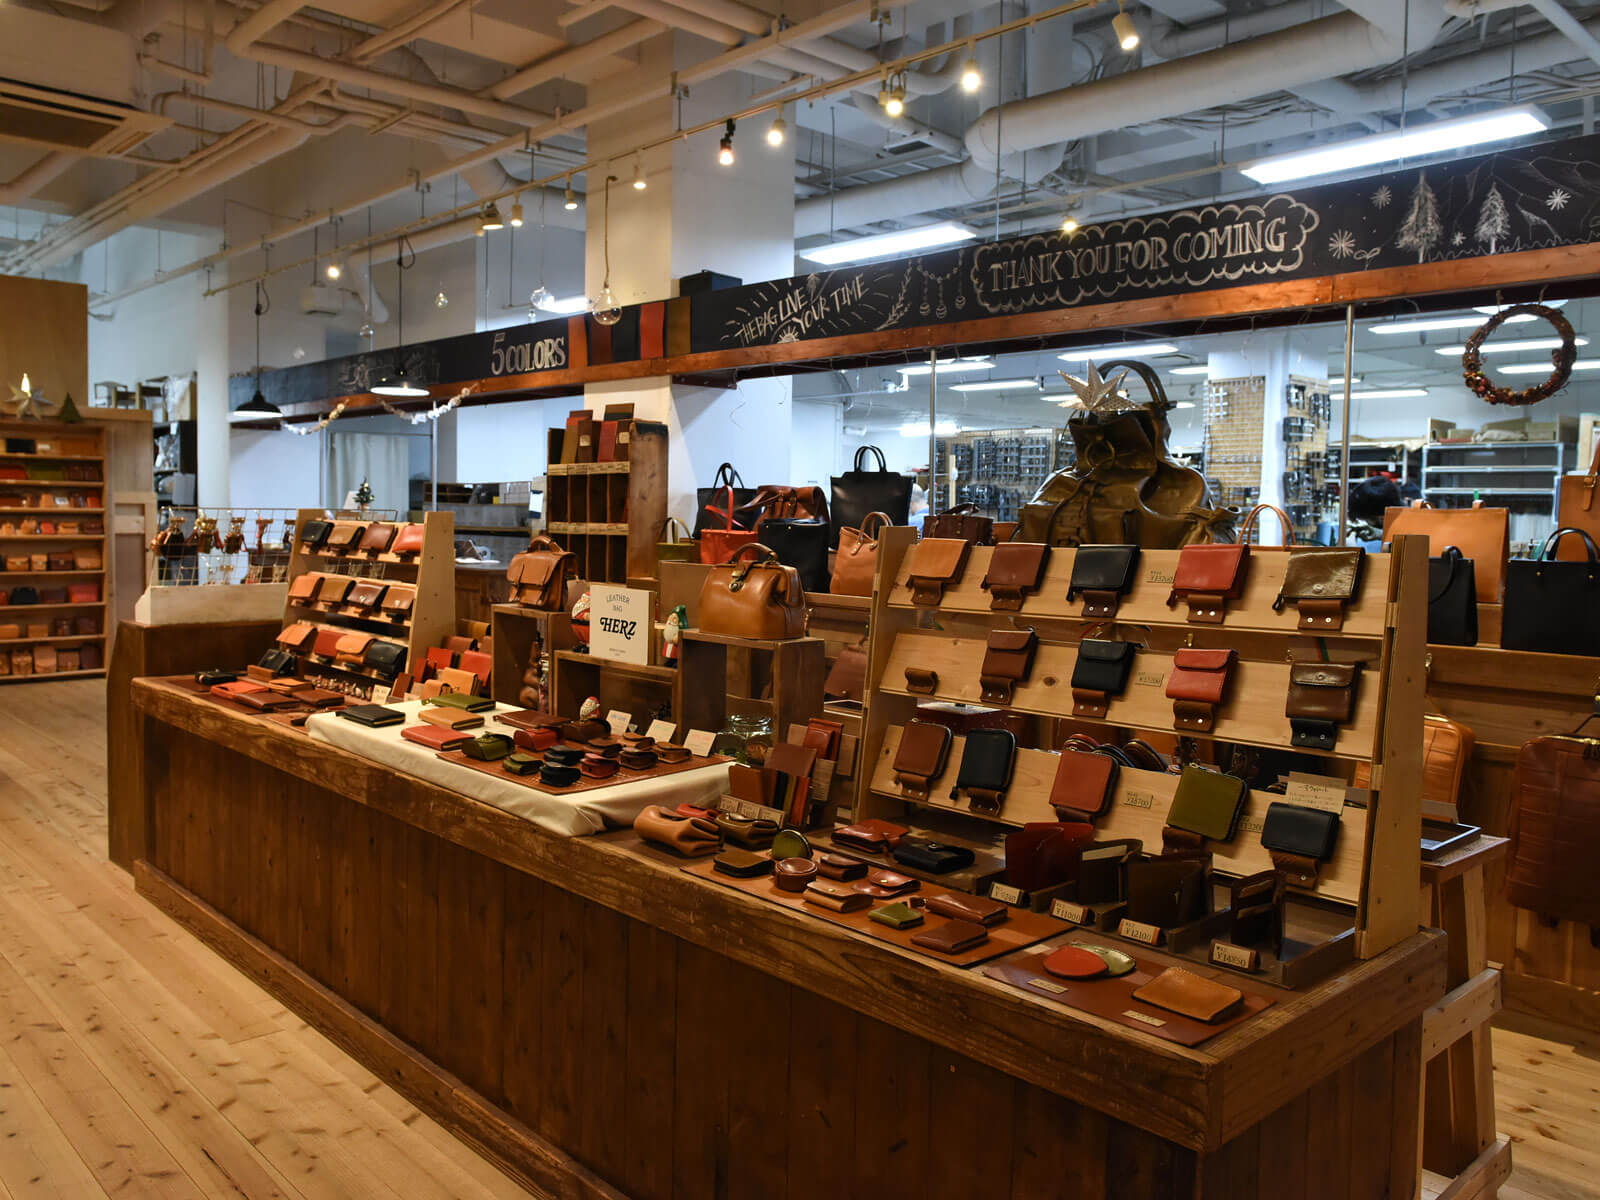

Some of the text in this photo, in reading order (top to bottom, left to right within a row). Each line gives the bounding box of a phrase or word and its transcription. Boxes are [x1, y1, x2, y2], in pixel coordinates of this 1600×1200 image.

[991, 215, 1287, 292] THANK YOU FOR COMING
[791, 272, 869, 335] YOUR TIME
[734, 319, 758, 347] THE
[755, 306, 778, 337] BAG
[491, 331, 566, 376] 5 COLORS
[606, 593, 631, 605] LEATHER
[600, 616, 637, 641] HERZ
